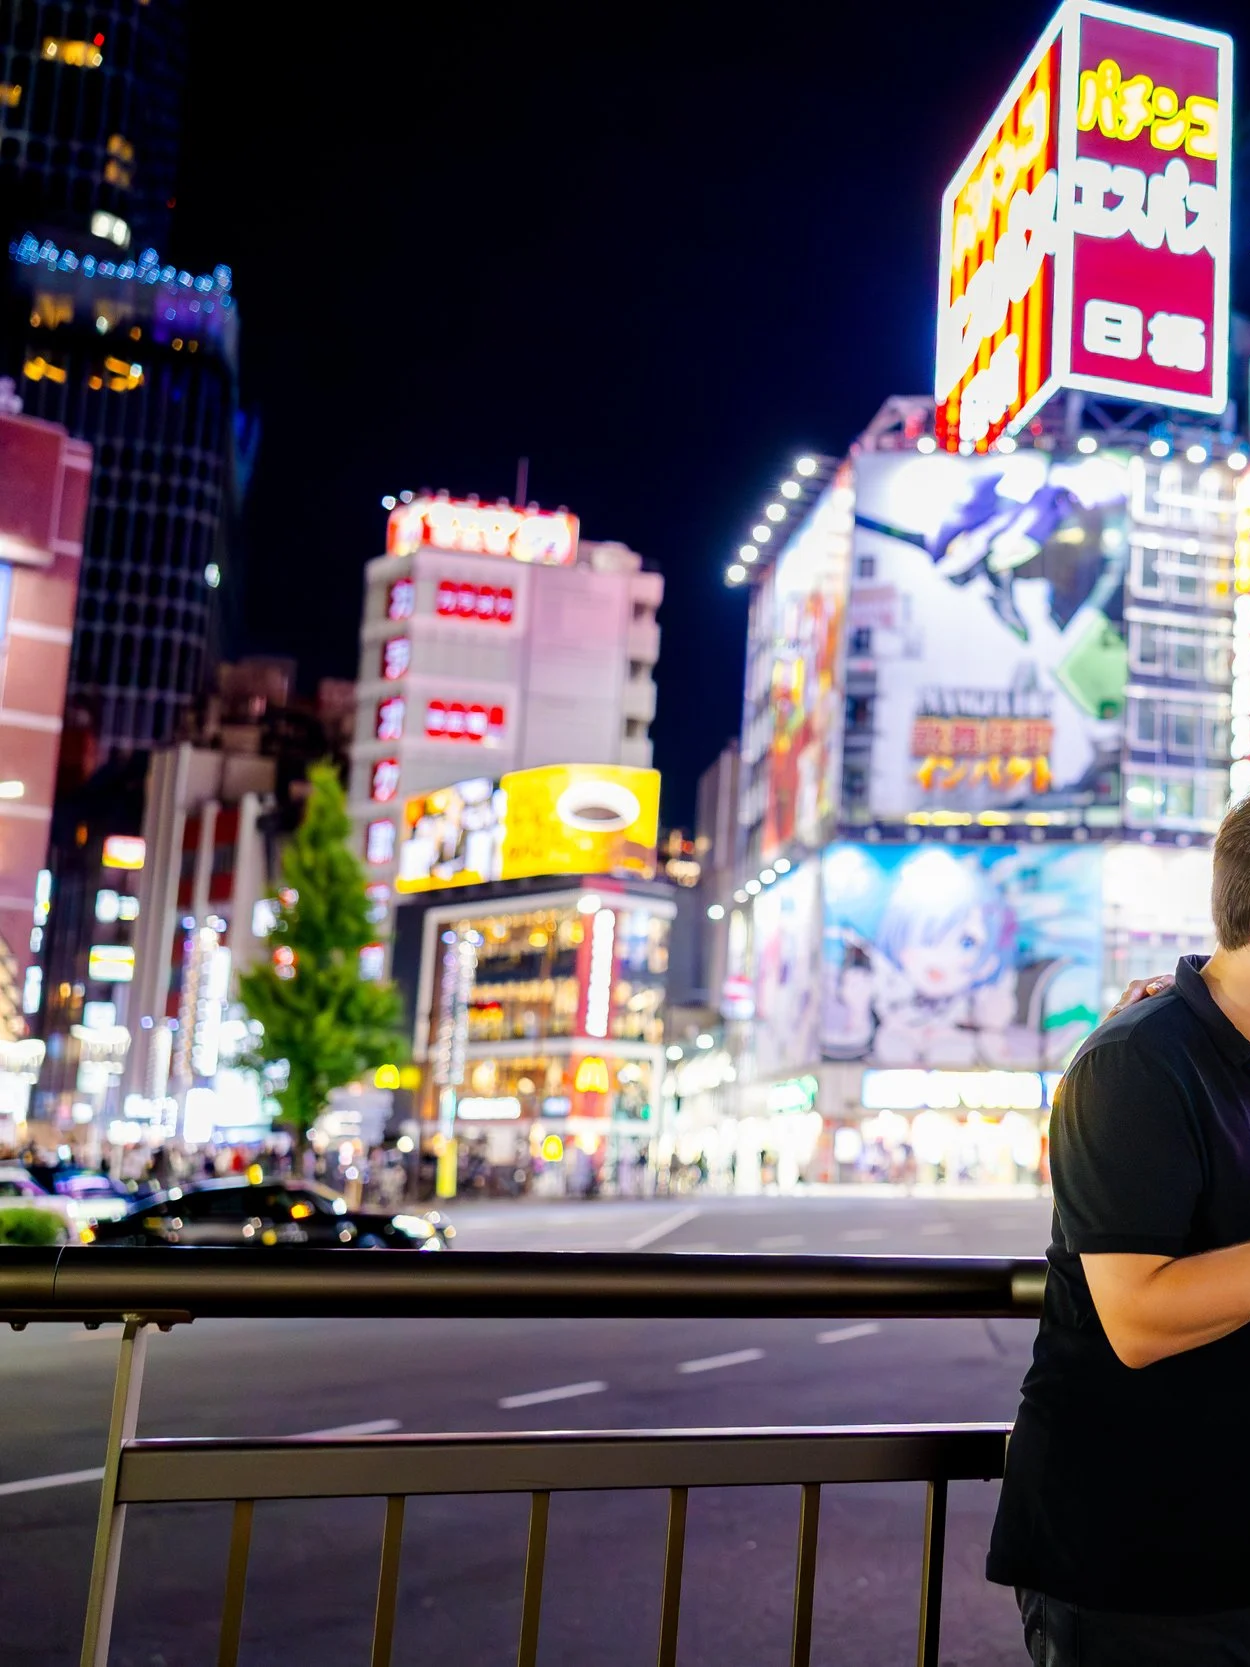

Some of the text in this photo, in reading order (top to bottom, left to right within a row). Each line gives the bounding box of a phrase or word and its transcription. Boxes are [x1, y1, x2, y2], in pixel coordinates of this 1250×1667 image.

[1077, 59, 1218, 160] パチンコ
[1073, 157, 1218, 258] エスパス
